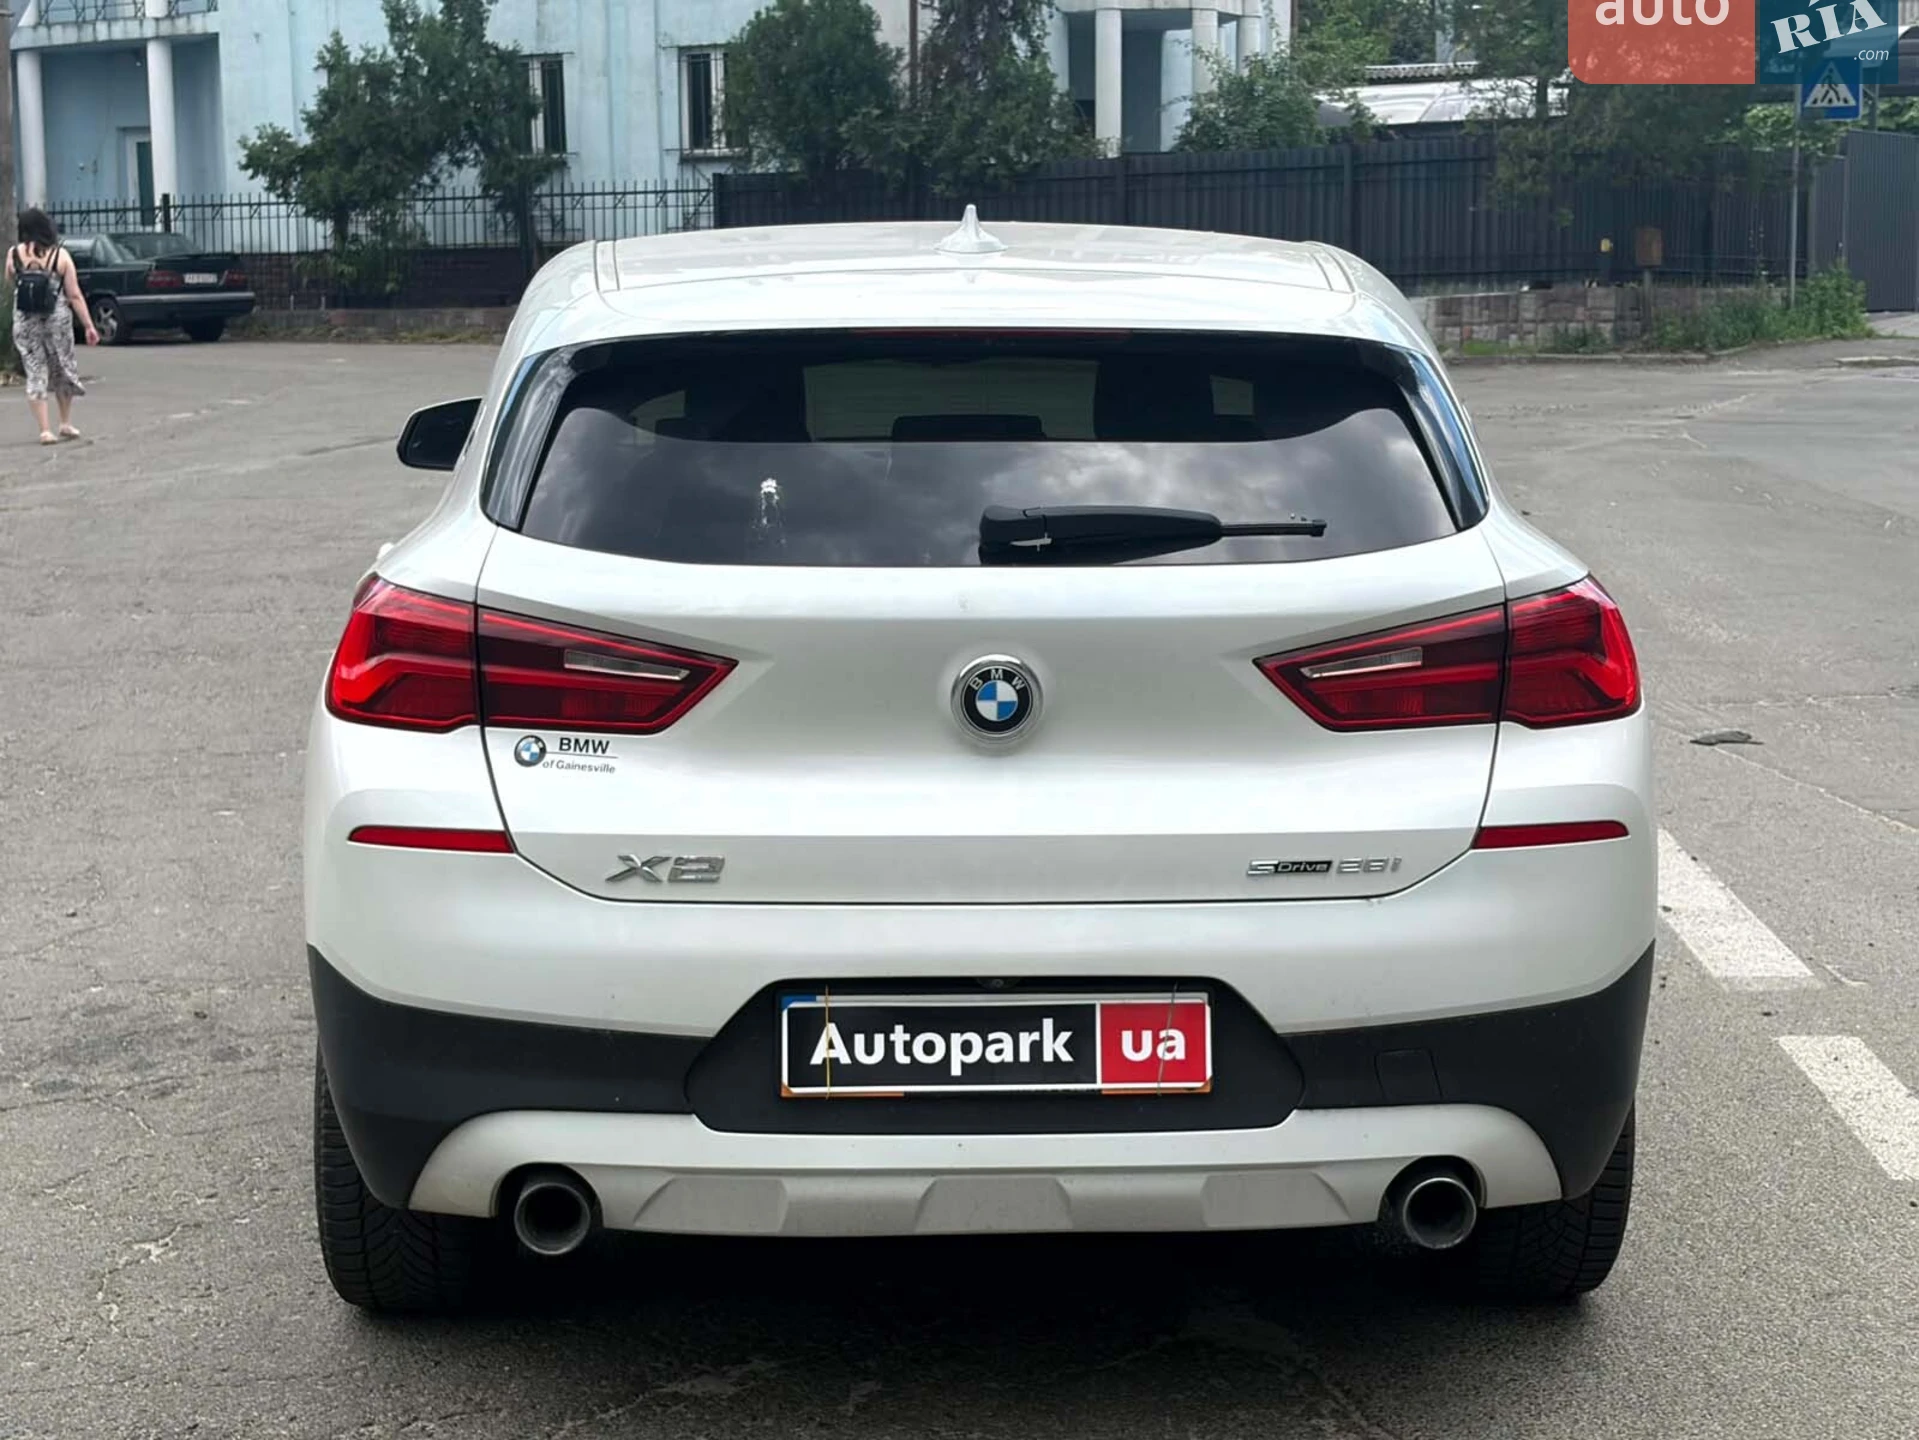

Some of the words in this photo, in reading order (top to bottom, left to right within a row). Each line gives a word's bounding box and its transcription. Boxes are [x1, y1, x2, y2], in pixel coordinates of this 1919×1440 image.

[969, 668, 1026, 691] BMW
[558, 737, 610, 755] BMW
[542, 760, 555, 769] of
[556, 760, 616, 774] Gainesville
[604, 853, 726, 884] X2
[809, 1017, 1074, 1077] Autopark
[1120, 1028, 1187, 1062] ua
